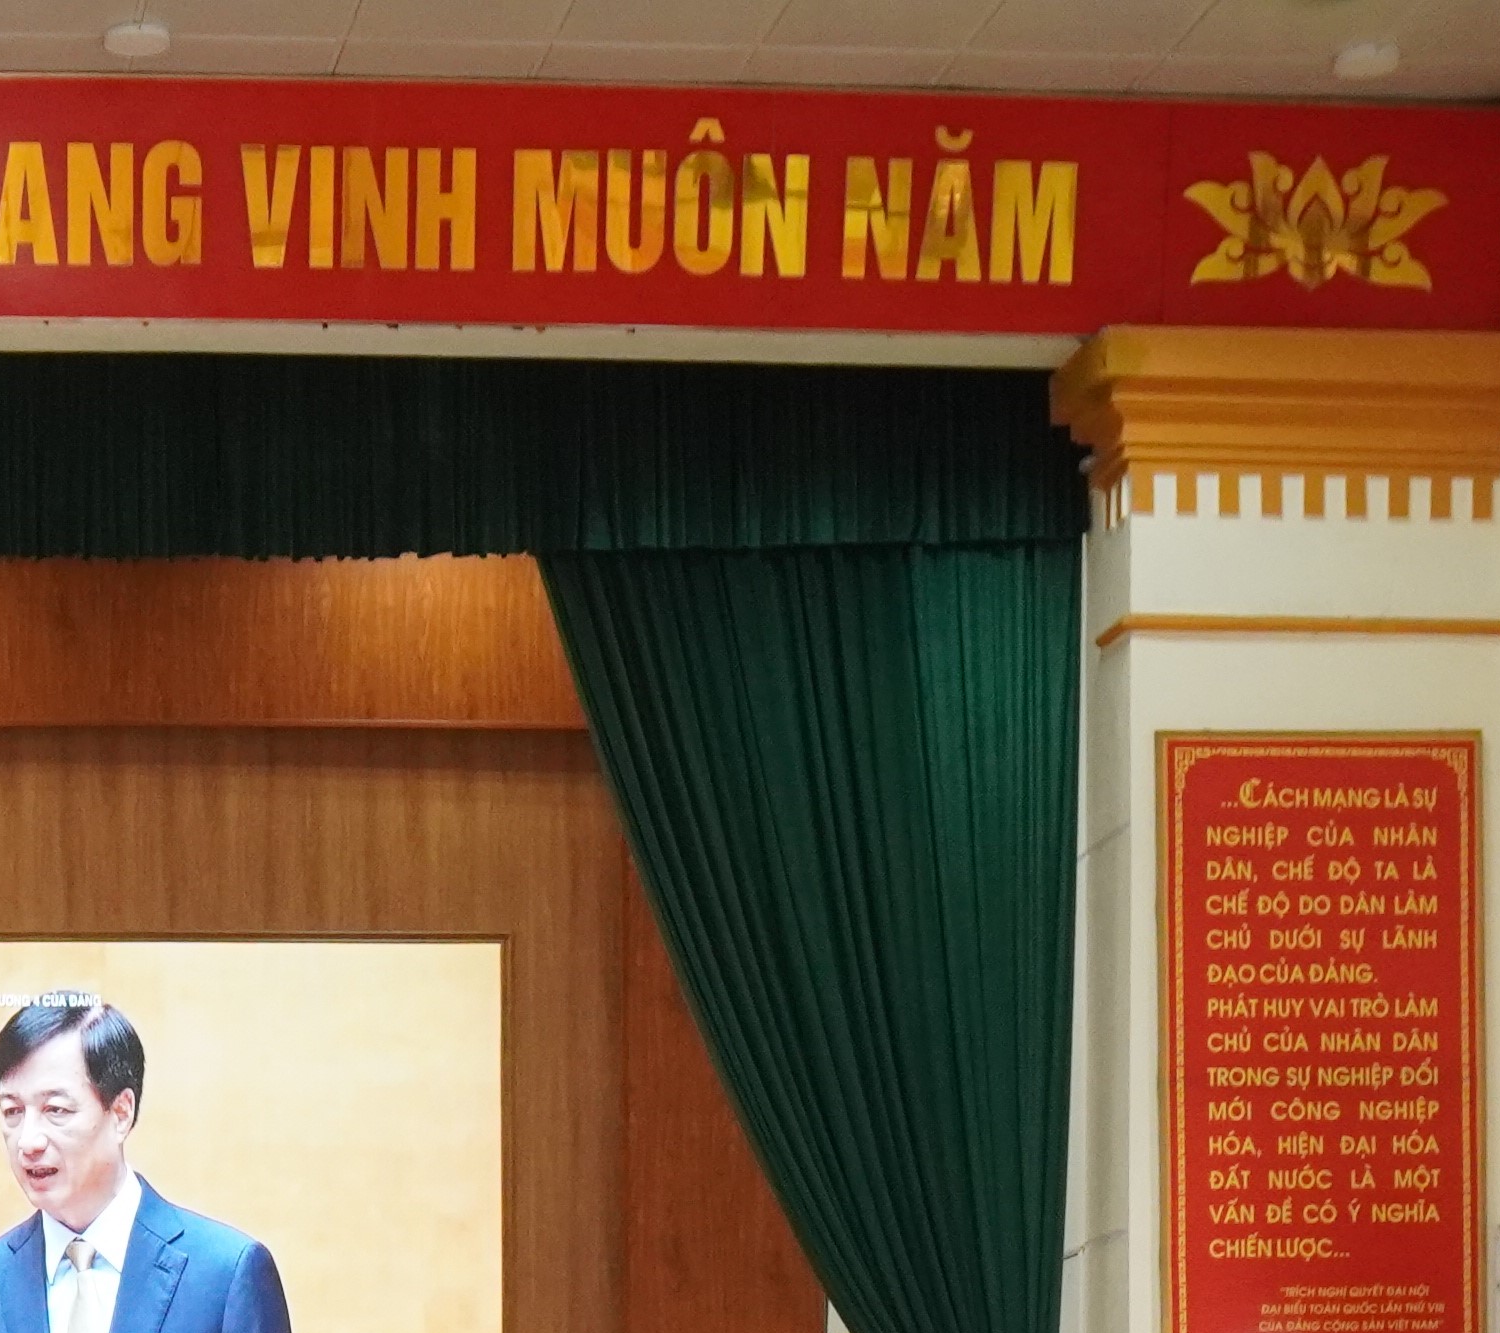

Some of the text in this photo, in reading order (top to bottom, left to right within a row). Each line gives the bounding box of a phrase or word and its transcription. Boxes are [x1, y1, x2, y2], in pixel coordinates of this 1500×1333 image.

[239, 143, 478, 272] VINH
[511, 117, 812, 280] MUÔN
[840, 124, 1080, 287] NĂM
[1312, 788, 1382, 811] MẠNG
[1384, 783, 1410, 808] LÀ
[1412, 788, 1438, 811] SỰ
[1205, 820, 1438, 850] NGHIỆP CỦA NHÂN
[1271, 855, 1316, 880] CHẾ
[1327, 857, 1362, 884] ĐỘ
[1374, 861, 1399, 880] TA
[1412, 856, 1438, 880] LÀ
[1205, 889, 1438, 918] CHẾ ĐỘ DO DÂN LÀM
[1205, 923, 1438, 953] CHỦ DƯỚI SỰ LÃNH
[1206, 964, 1257, 988] ĐẠO
[1258, 957, 1305, 984] CỦA
[1206, 993, 1439, 1018] PHÁT HUY VAI TRÒ LÀM
[1206, 1026, 1439, 1053] CHỦ CỦA NHÂN DÂN
[1206, 1058, 1439, 1090] TRONG SỰ NGHIỆP ĐỔI
[1207, 1096, 1440, 1123] MỚI CÔNG NGHIỆP
[1277, 1131, 1324, 1158] HIỆN
[1339, 1135, 1377, 1158] ĐẠI
[1392, 1130, 1440, 1154] HÓA
[1207, 1164, 1441, 1192] ĐẤT NƯỚC LÀ MỘT
[1208, 1196, 1440, 1224] VẤN ĐỀ CÓ Ý NGHĨA
[1207, 1232, 1273, 1259] CHIẾN
